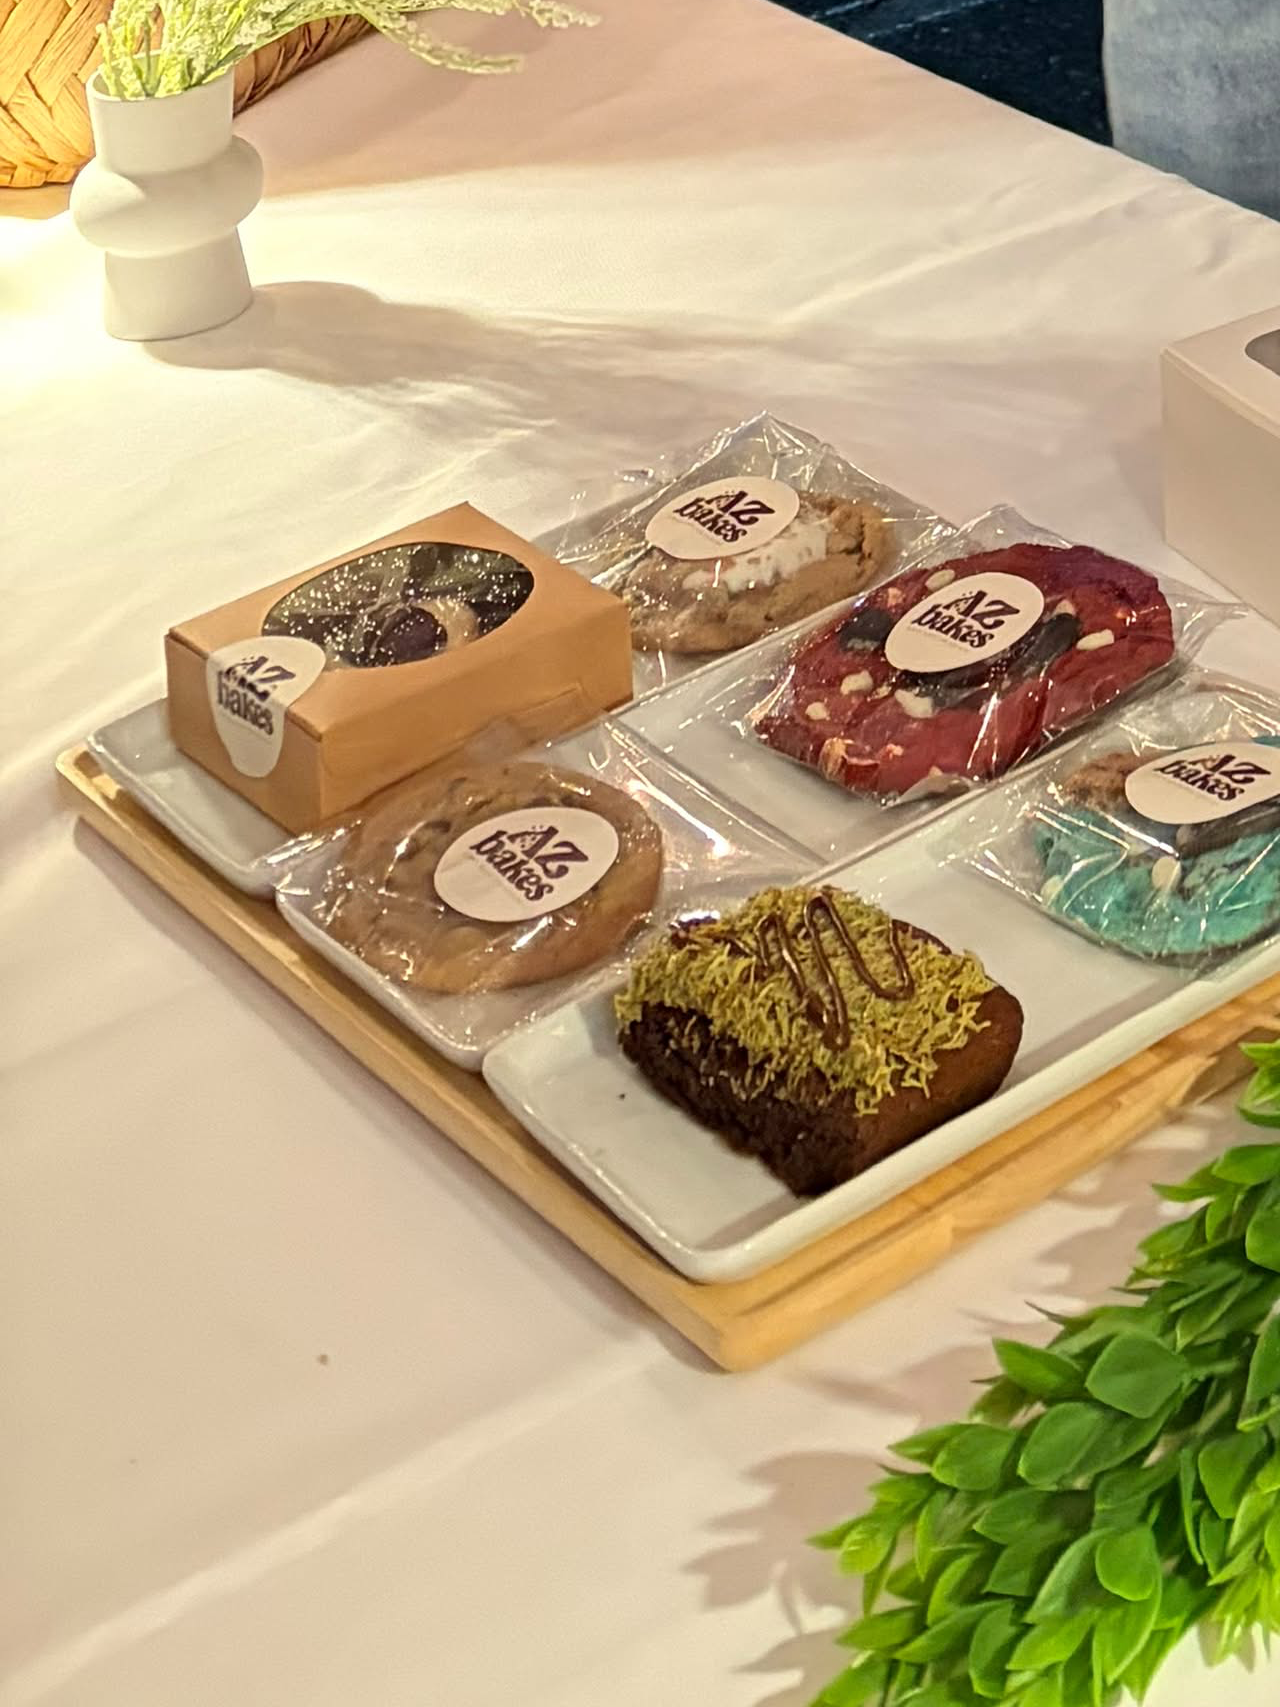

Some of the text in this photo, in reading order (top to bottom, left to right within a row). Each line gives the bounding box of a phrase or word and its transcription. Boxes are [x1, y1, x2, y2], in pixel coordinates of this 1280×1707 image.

[672, 496, 748, 543] bakes
[705, 489, 775, 526] AZ
[911, 603, 995, 649] bakes
[942, 589, 1021, 630] AZ
[217, 670, 274, 736] bakes
[1152, 759, 1245, 801] bakes
[1187, 753, 1272, 785] AZ
[468, 829, 554, 902] bakes
[506, 824, 590, 880] AZ
